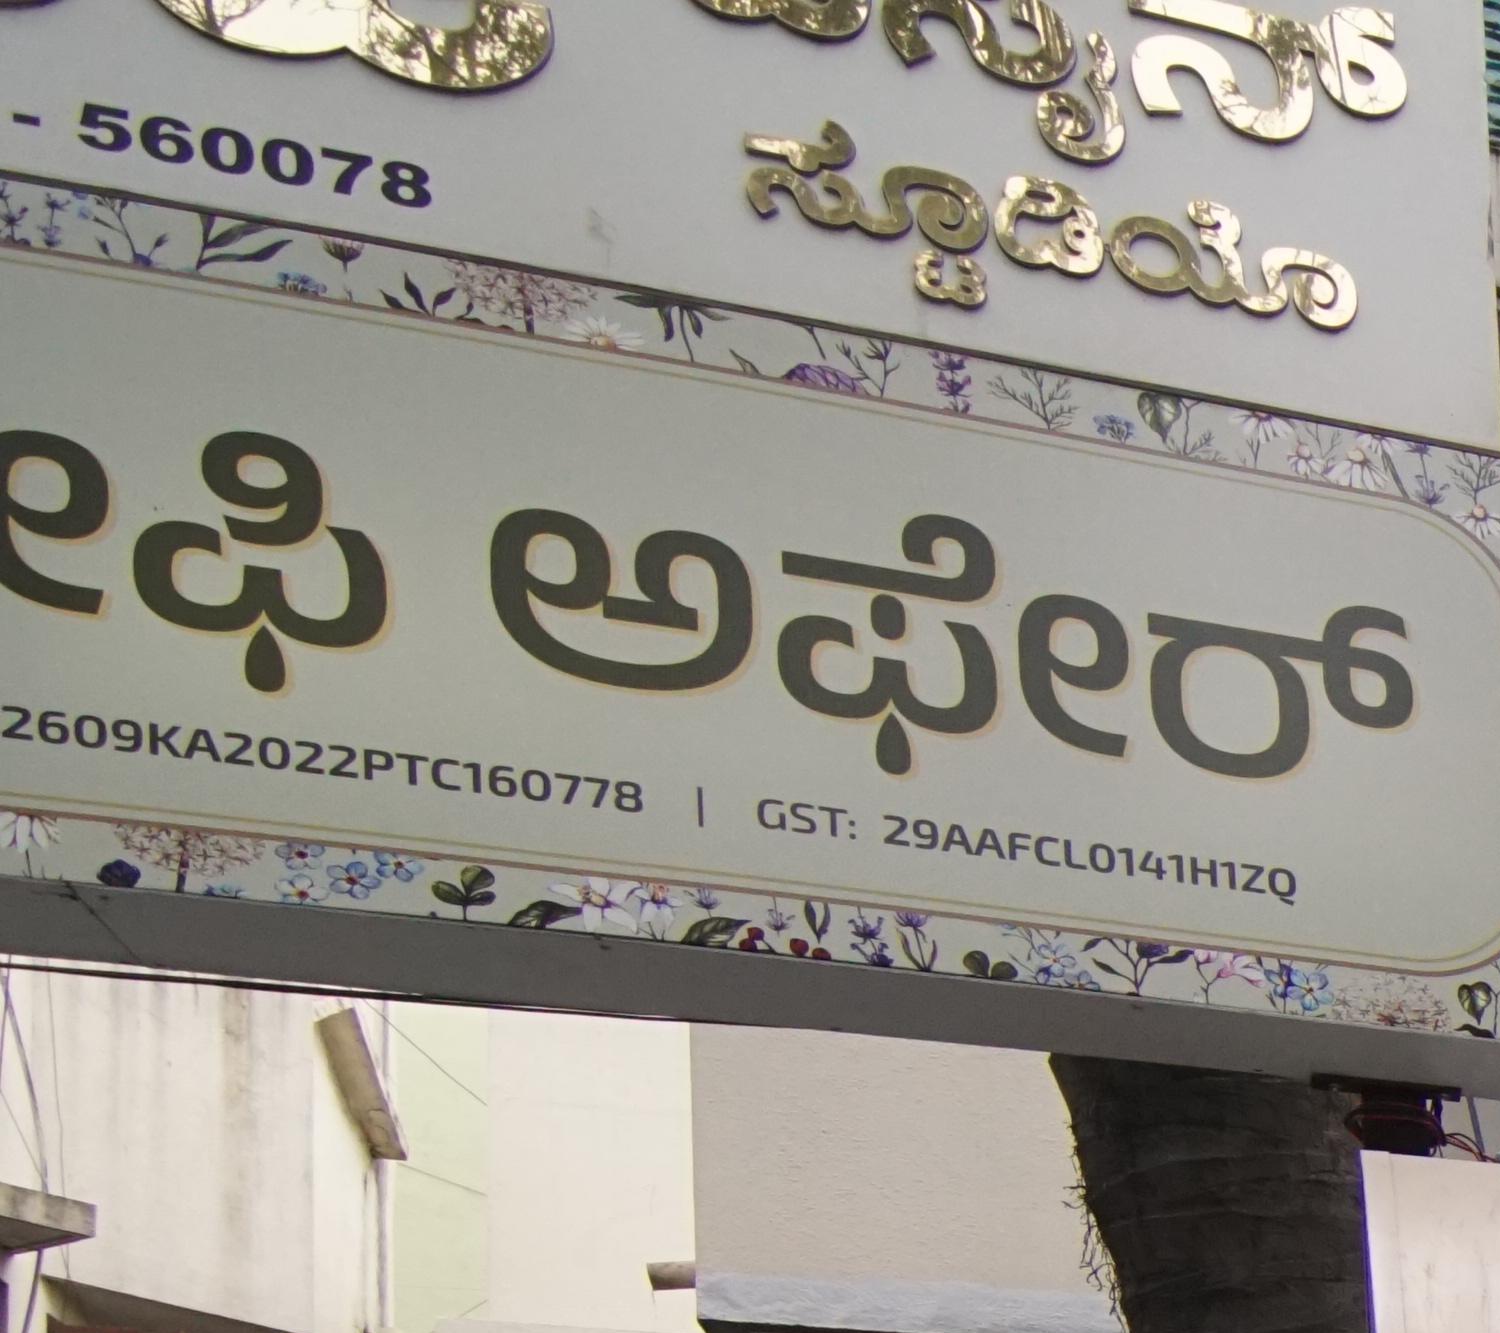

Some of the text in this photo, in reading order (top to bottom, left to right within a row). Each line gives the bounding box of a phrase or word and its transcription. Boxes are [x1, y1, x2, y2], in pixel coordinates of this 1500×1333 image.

[77, 102, 433, 209] 560078
[490, 506, 1417, 782] ಅಫೇರ್
[1, 705, 645, 813] 2609KA2022PTC160778
[756, 798, 858, 840] GST:
[883, 814, 1298, 906] 29AAFCL0141H1ZQ
